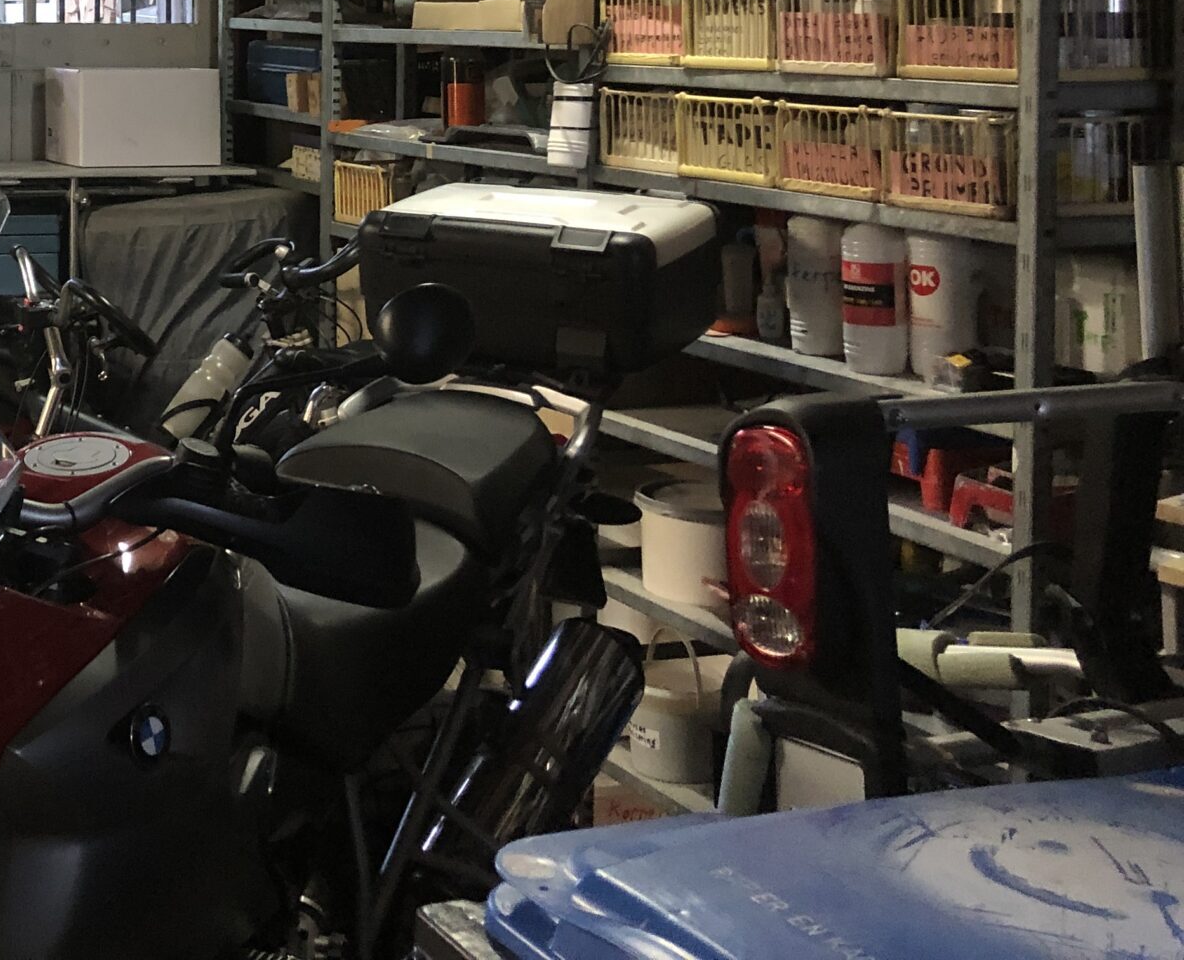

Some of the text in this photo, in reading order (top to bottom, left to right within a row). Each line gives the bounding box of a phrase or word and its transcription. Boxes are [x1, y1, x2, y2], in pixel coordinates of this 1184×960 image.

[692, 121, 773, 151] TAPE
[900, 149, 989, 179] GROND
[909, 268, 937, 288] OK
[786, 913, 829, 937] EN
